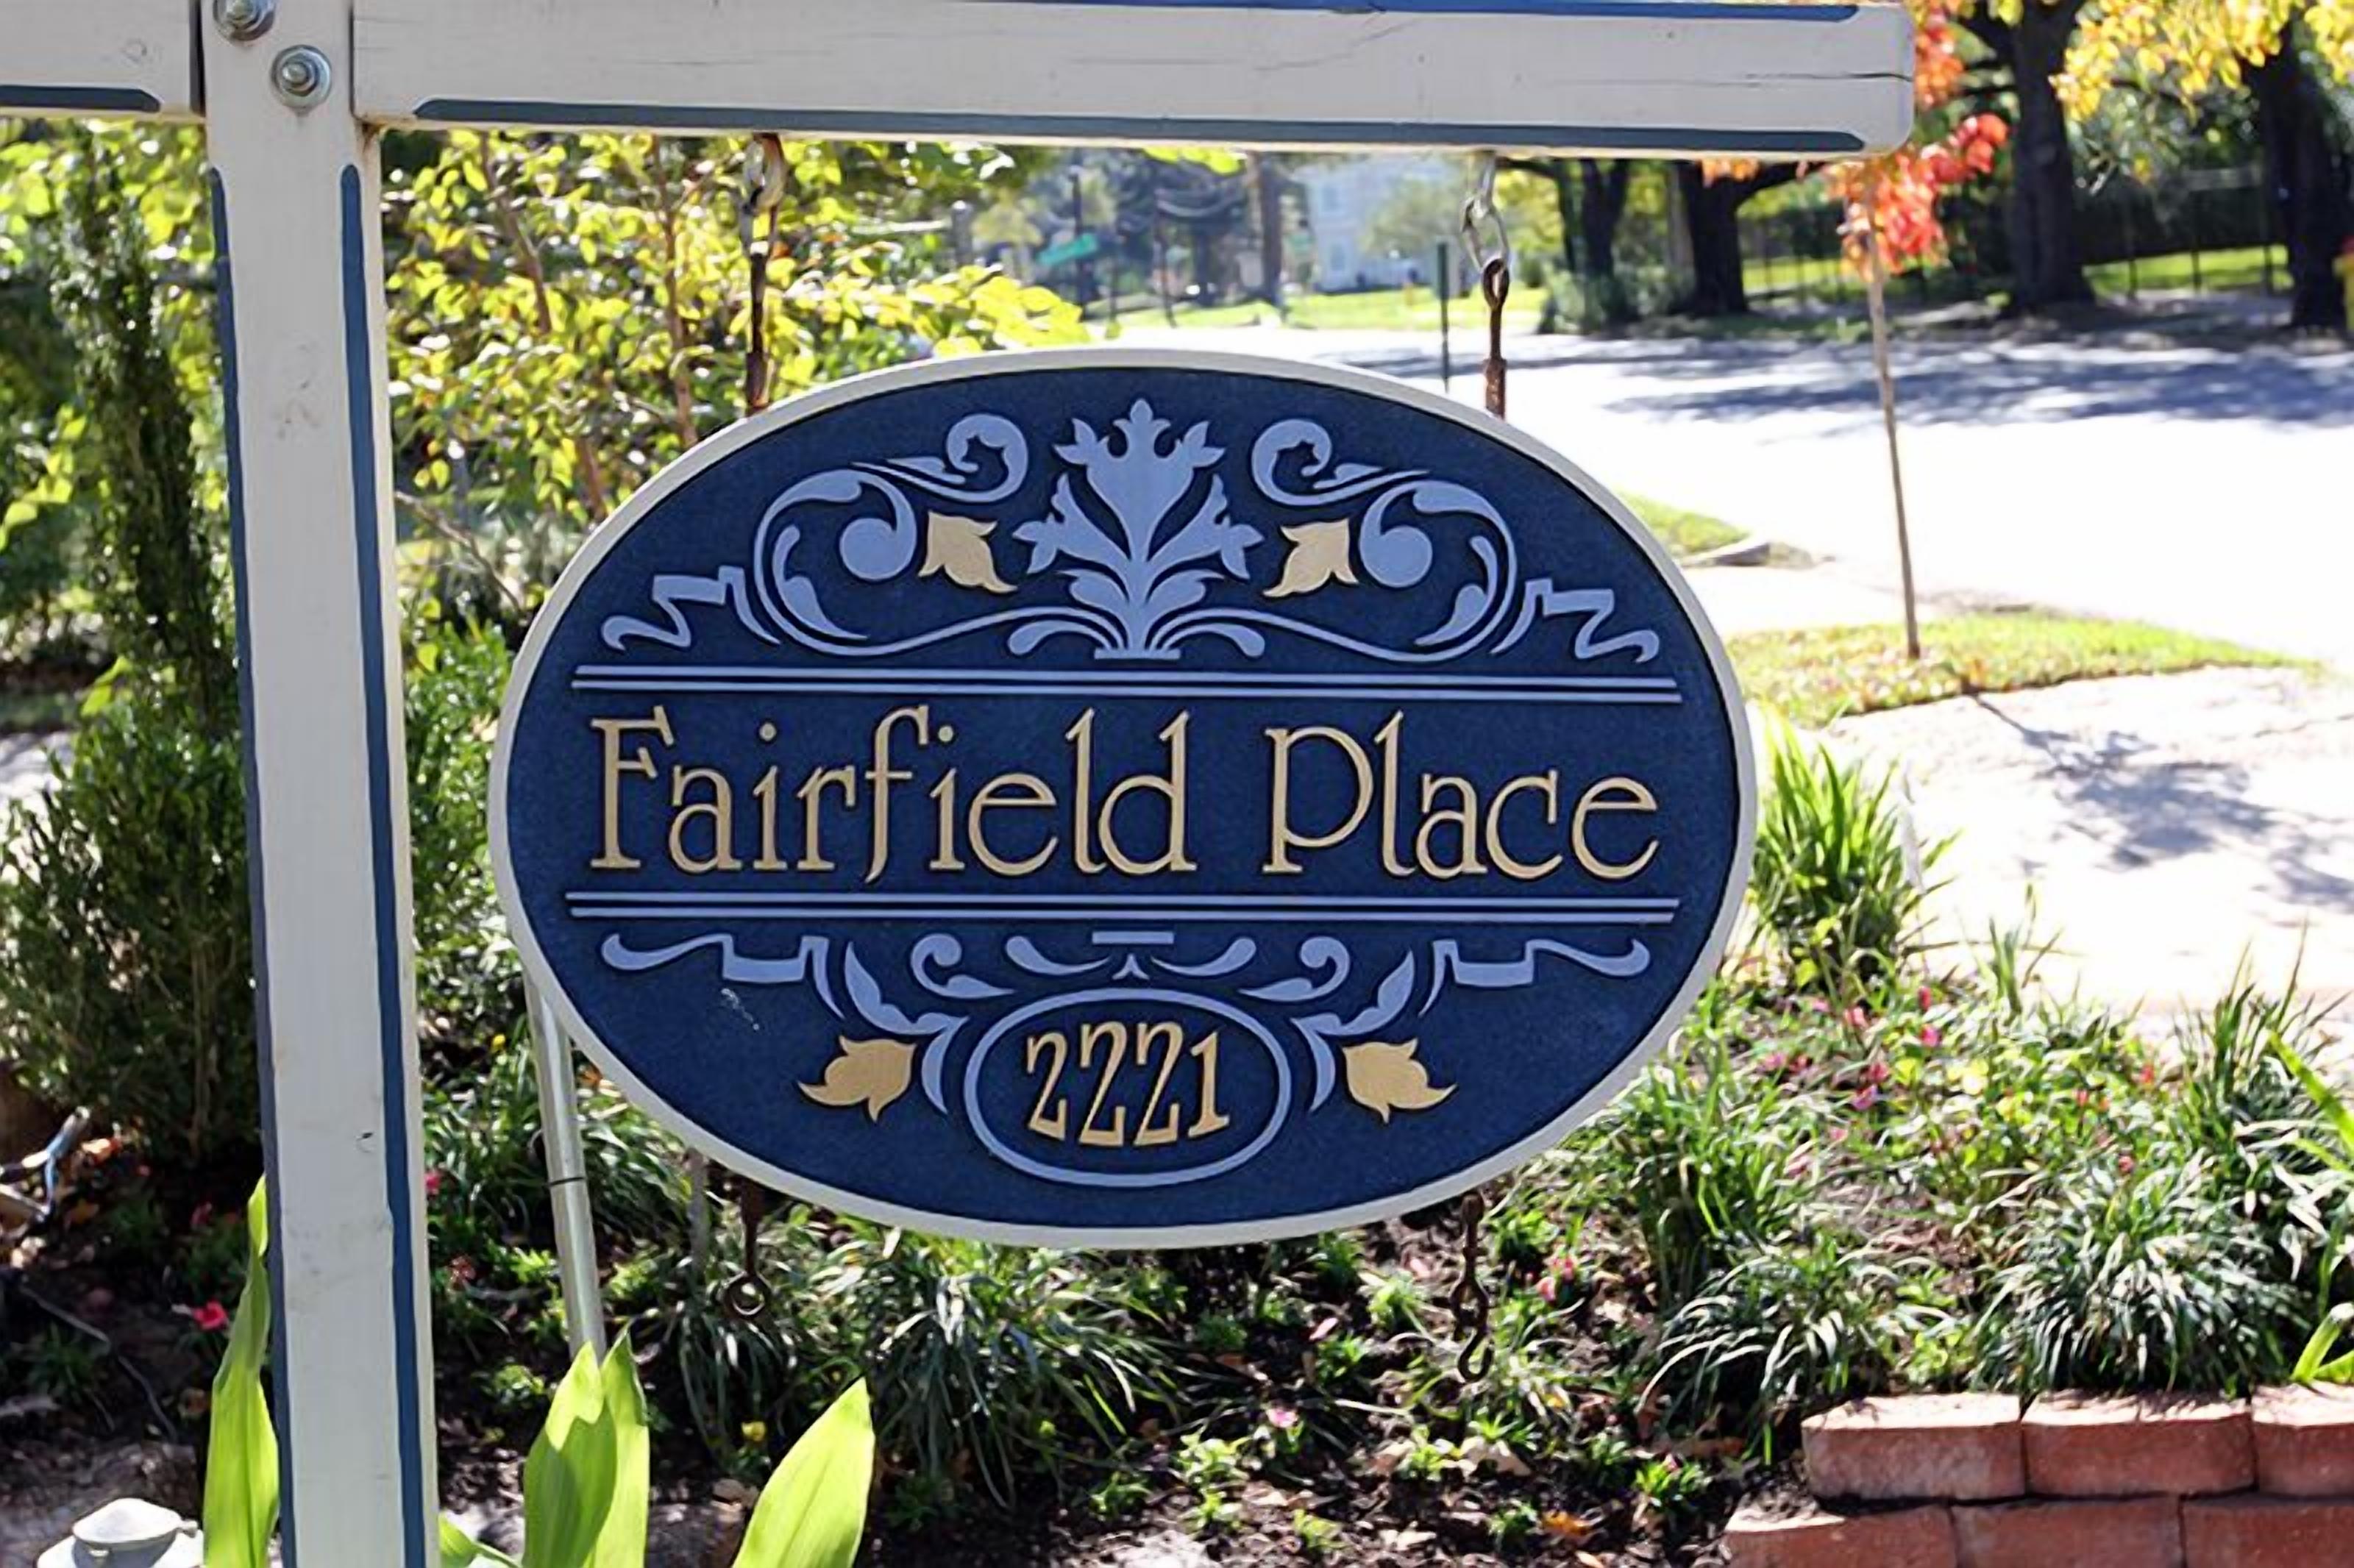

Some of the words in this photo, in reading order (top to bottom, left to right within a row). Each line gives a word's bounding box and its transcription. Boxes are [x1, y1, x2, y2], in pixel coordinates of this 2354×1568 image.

[591, 704, 1197, 884] Fairfield
[1264, 710, 1658, 880] Place
[1025, 1021, 1229, 1147] 2221
